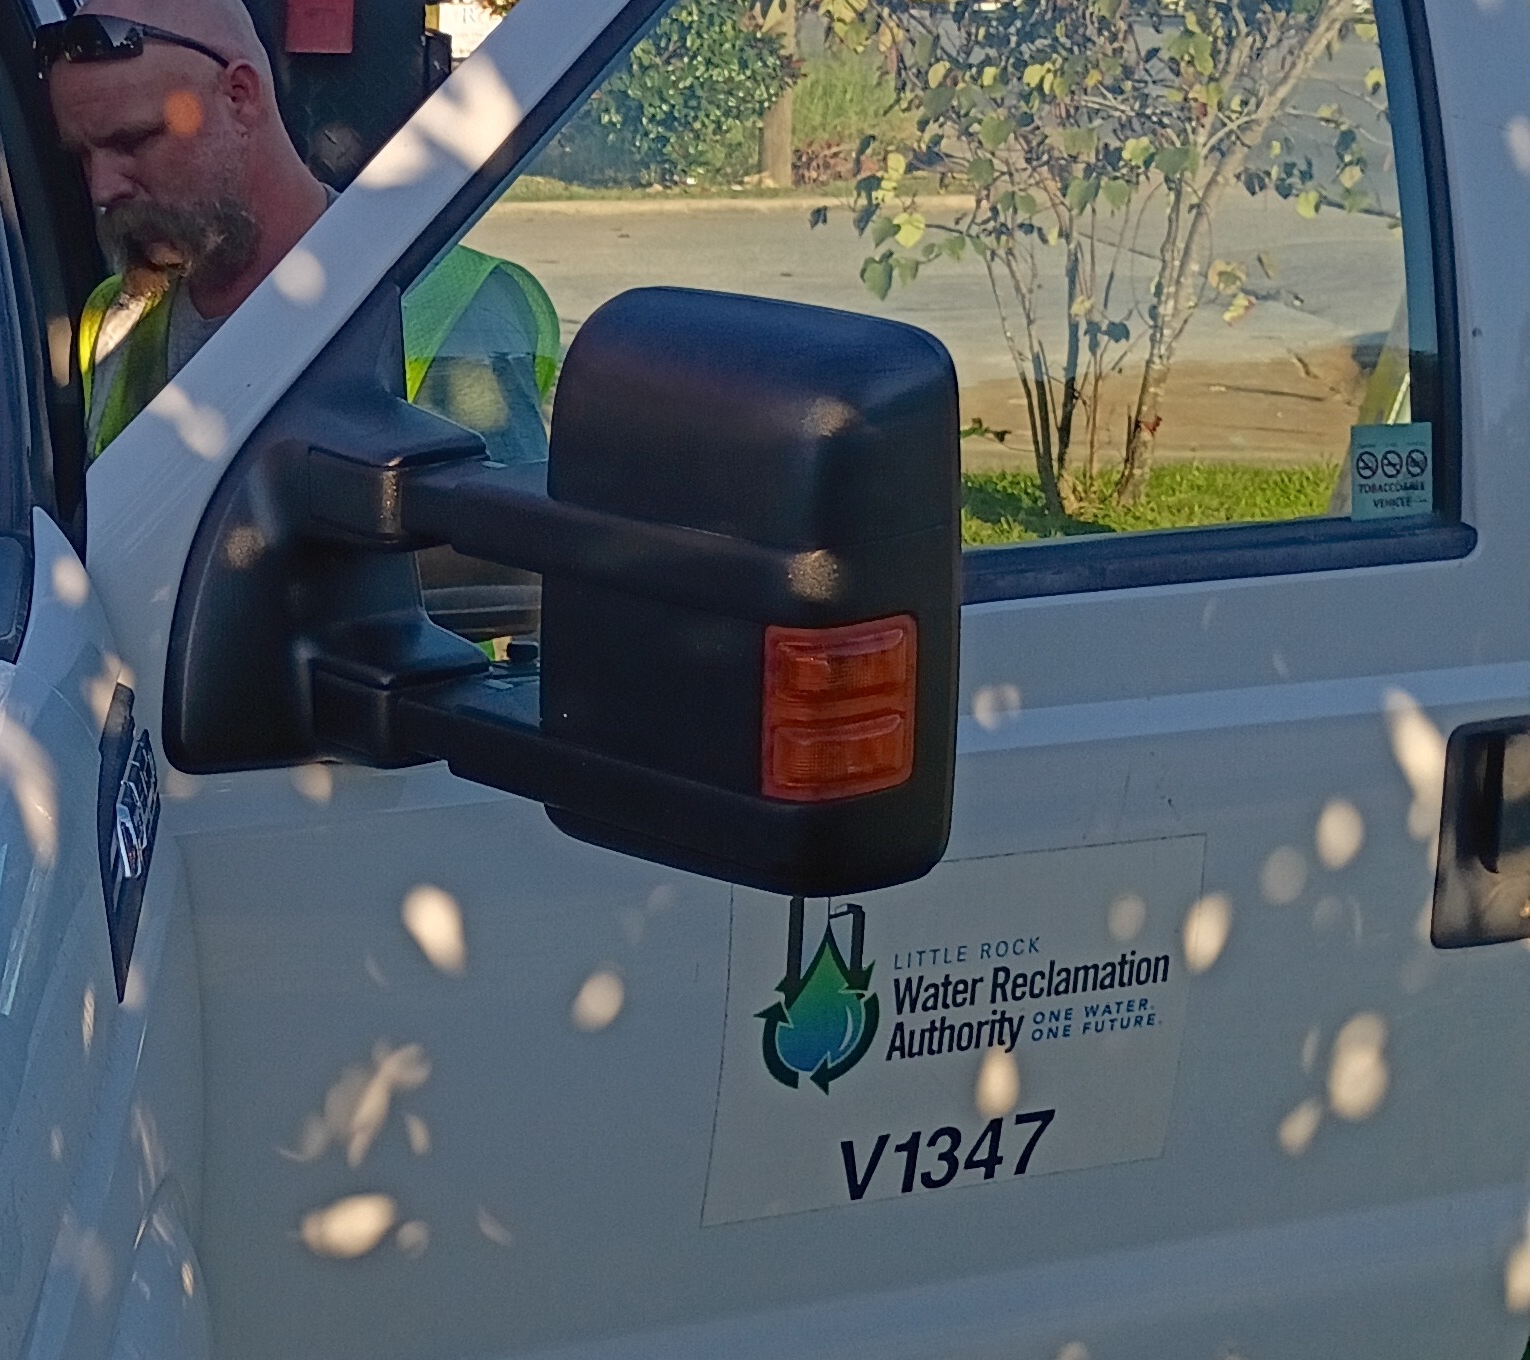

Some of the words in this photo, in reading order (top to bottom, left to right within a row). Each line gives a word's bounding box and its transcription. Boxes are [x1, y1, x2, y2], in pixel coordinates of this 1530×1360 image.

[893, 945, 967, 970] LITTLE
[980, 936, 1041, 960] ROCK
[893, 973, 985, 1016] Water
[990, 950, 1171, 1004] Reclamation
[885, 1009, 1025, 1061] Authority
[1031, 1022, 1072, 1042] ONE
[1032, 1006, 1074, 1025] ONE
[840, 1108, 1056, 1202] V1347
